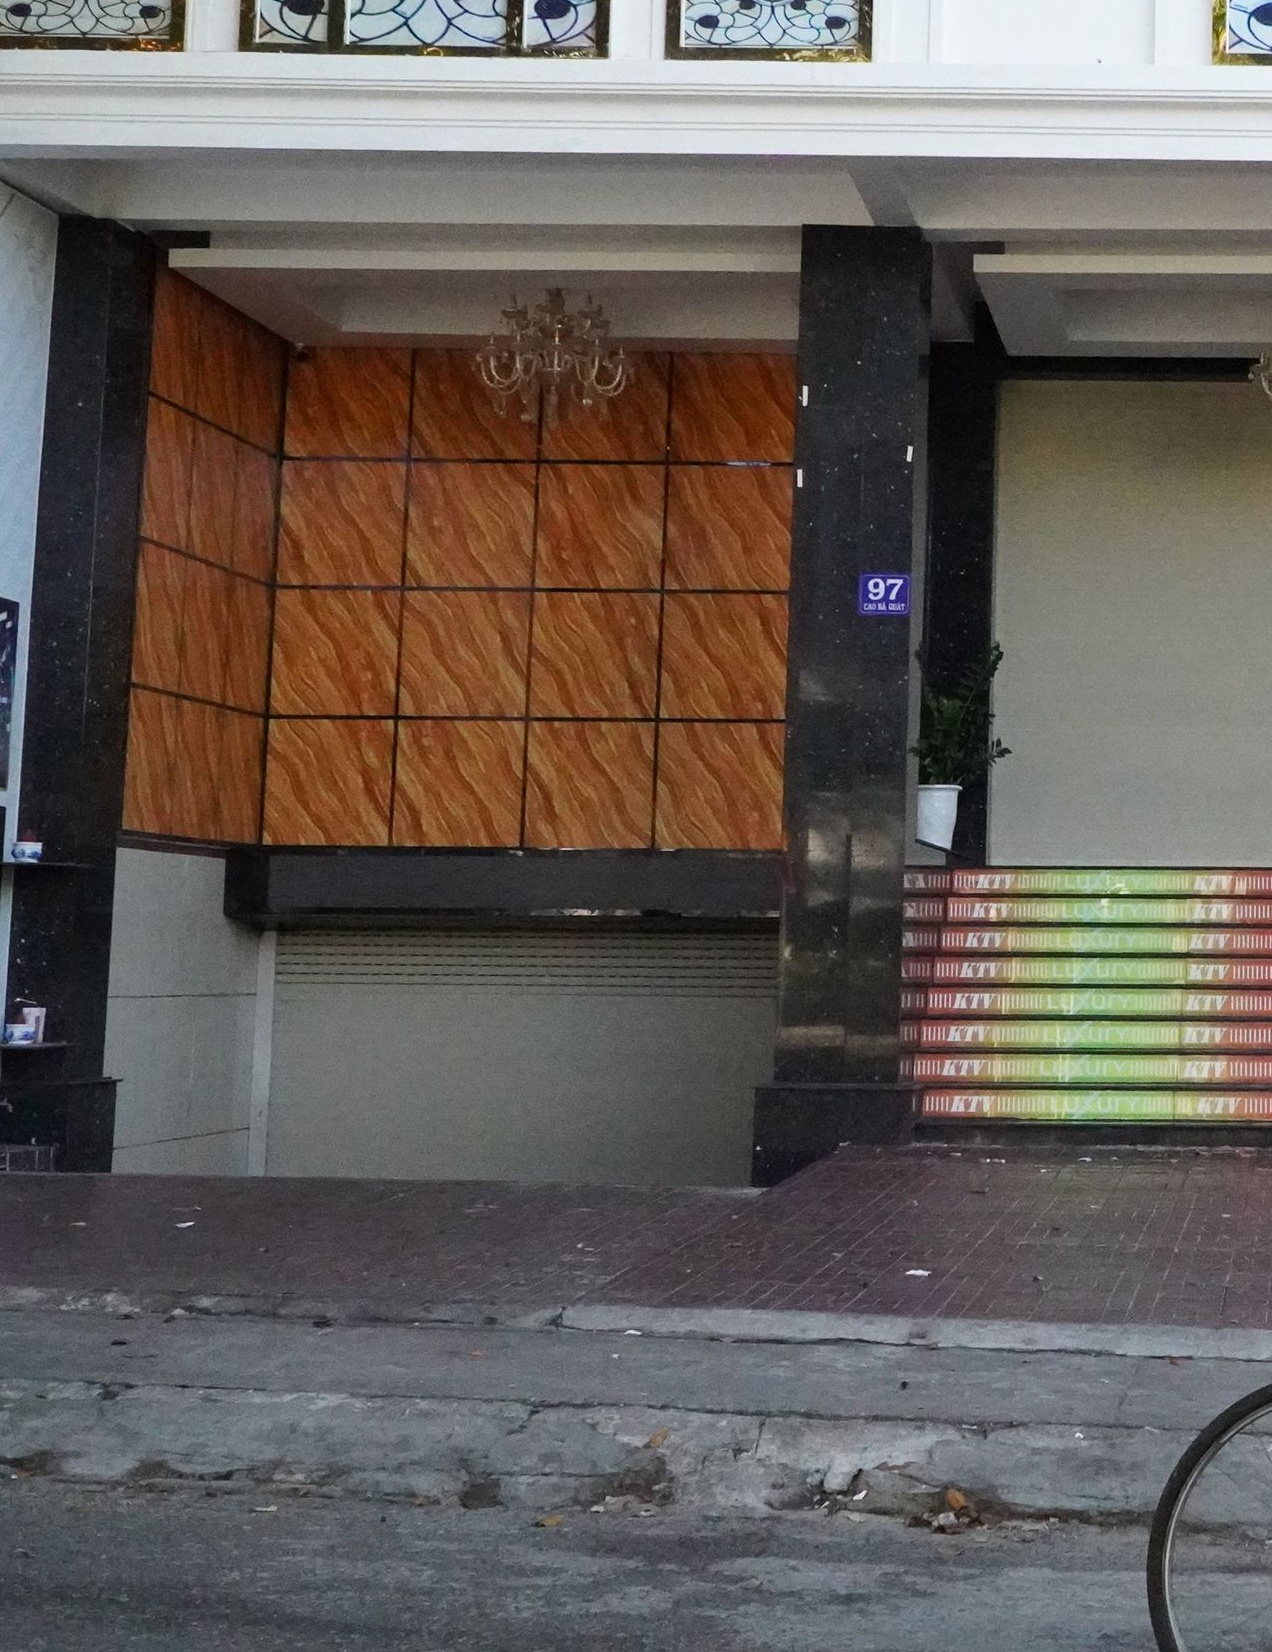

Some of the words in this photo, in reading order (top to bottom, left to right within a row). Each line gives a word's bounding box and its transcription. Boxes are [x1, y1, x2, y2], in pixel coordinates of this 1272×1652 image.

[868, 578, 904, 601] 97
[863, 603, 877, 611] CAO
[1193, 905, 1233, 918] KTV
[965, 932, 1005, 947] KTV
[1189, 934, 1230, 949] KTV
[959, 962, 1001, 977] KTV
[1187, 964, 1230, 979] KTV
[953, 993, 995, 1008] KTV
[1186, 995, 1227, 1011] KTV
[946, 1026, 990, 1041] KTV
[1183, 1028, 1227, 1044] KTV
[942, 1060, 985, 1076] KTV
[1183, 1061, 1227, 1077] KTV
[950, 1096, 994, 1112] KTV
[1197, 1097, 1240, 1113] KTV
